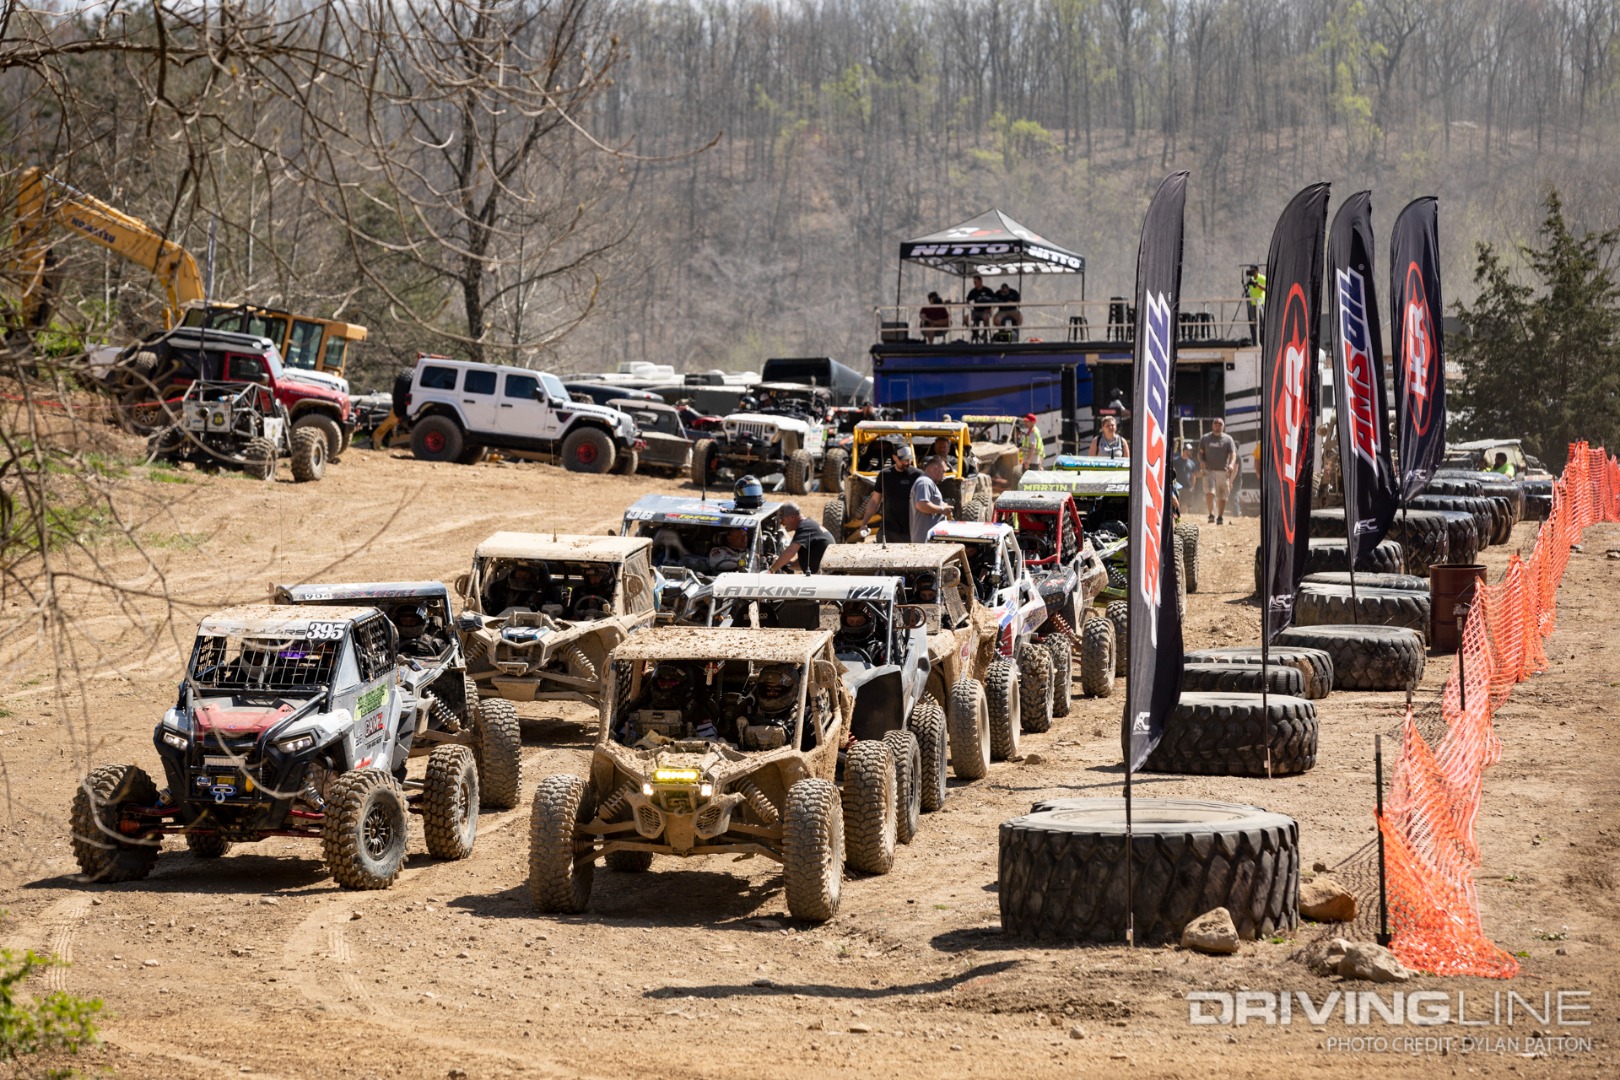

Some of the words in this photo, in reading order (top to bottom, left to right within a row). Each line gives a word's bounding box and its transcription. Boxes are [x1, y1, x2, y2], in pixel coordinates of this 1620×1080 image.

[910, 243, 1010, 256] NITTO
[1027, 246, 1082, 269] NITTO
[1408, 299, 1427, 397] HCR
[1337, 266, 1381, 474] AMSOIL
[1141, 288, 1171, 630] AMSOIL
[724, 586, 817, 597] ATKINS
[1269, 594, 1291, 608] ASC
[307, 622, 346, 639] 395
